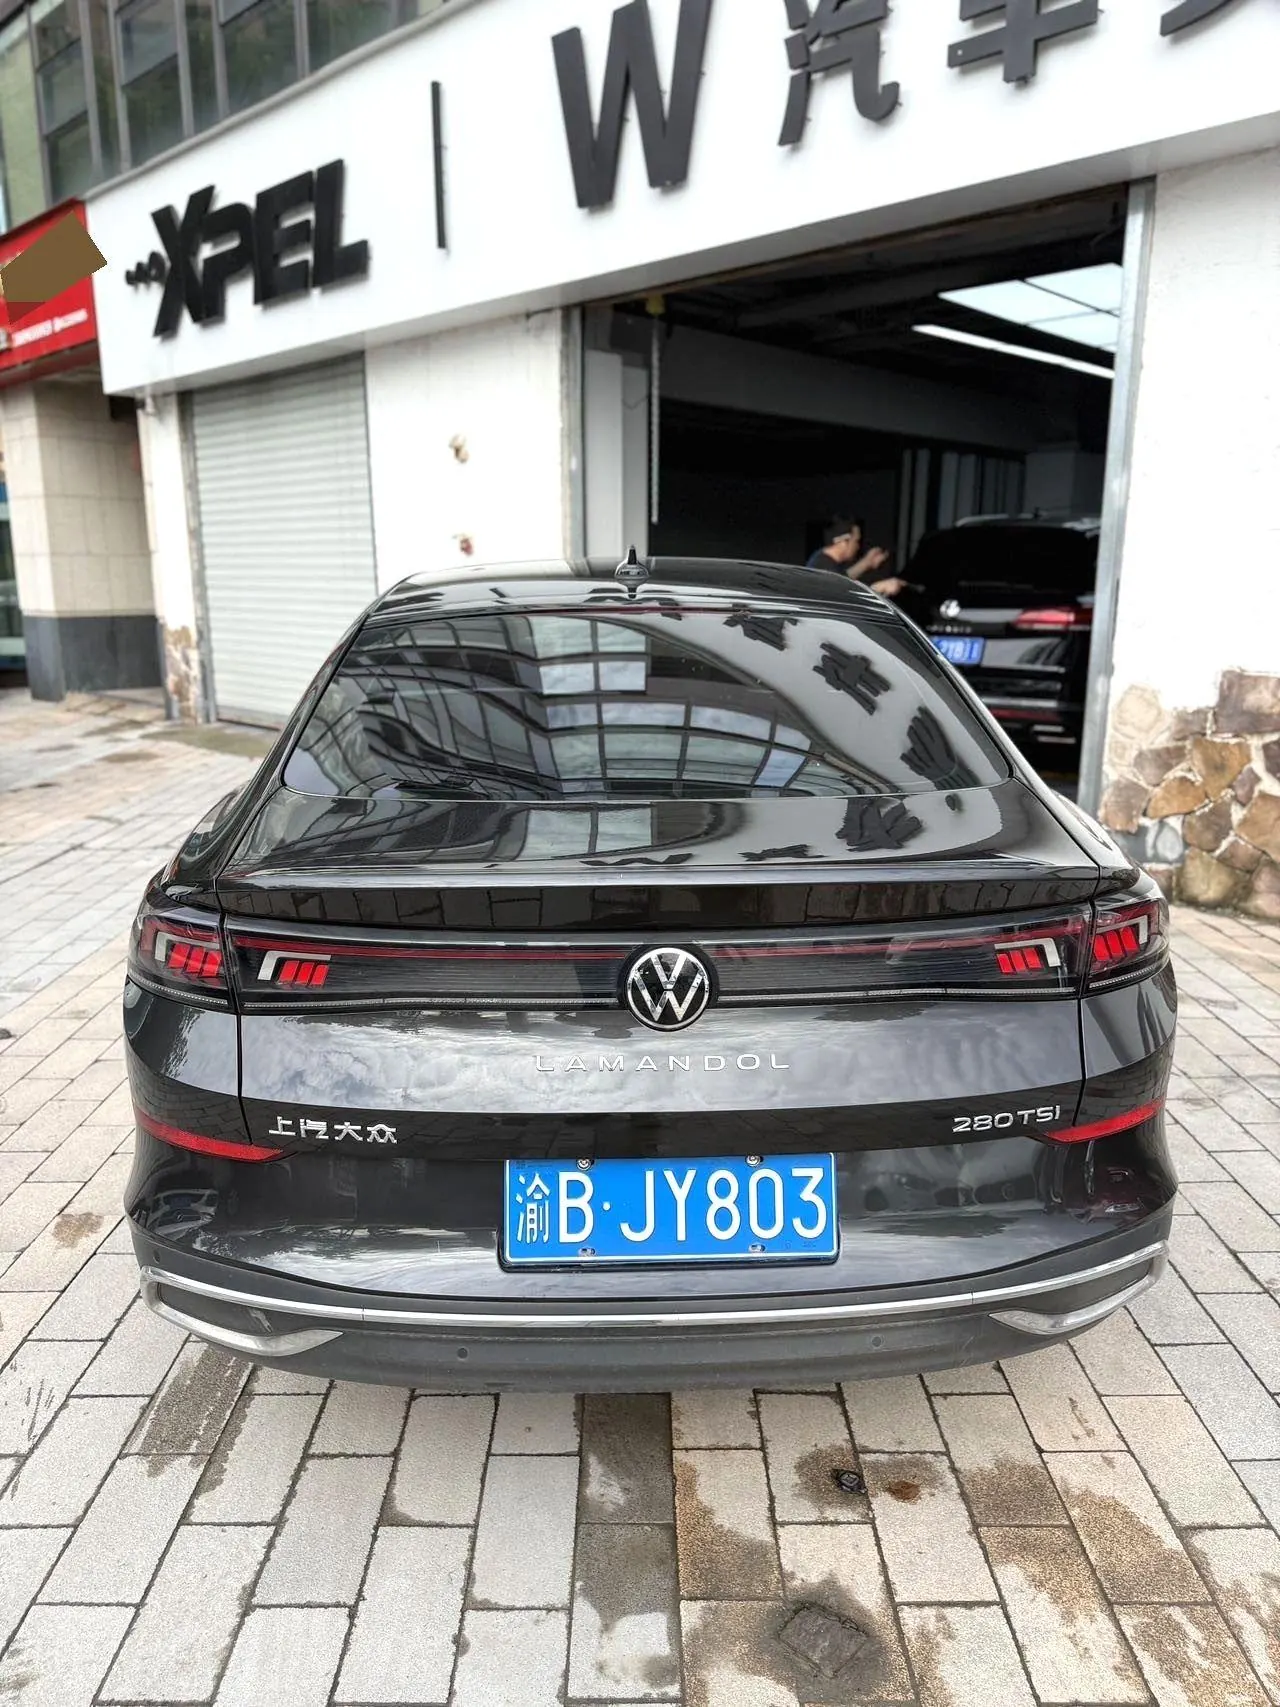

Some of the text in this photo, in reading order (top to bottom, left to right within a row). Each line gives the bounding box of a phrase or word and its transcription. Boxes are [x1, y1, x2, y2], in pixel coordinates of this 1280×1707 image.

[551, 0, 712, 208] W
[150, 158, 369, 338] XPEL
[535, 1053, 790, 1072] LAMANDOL
[268, 1115, 398, 1144] 上汽大众
